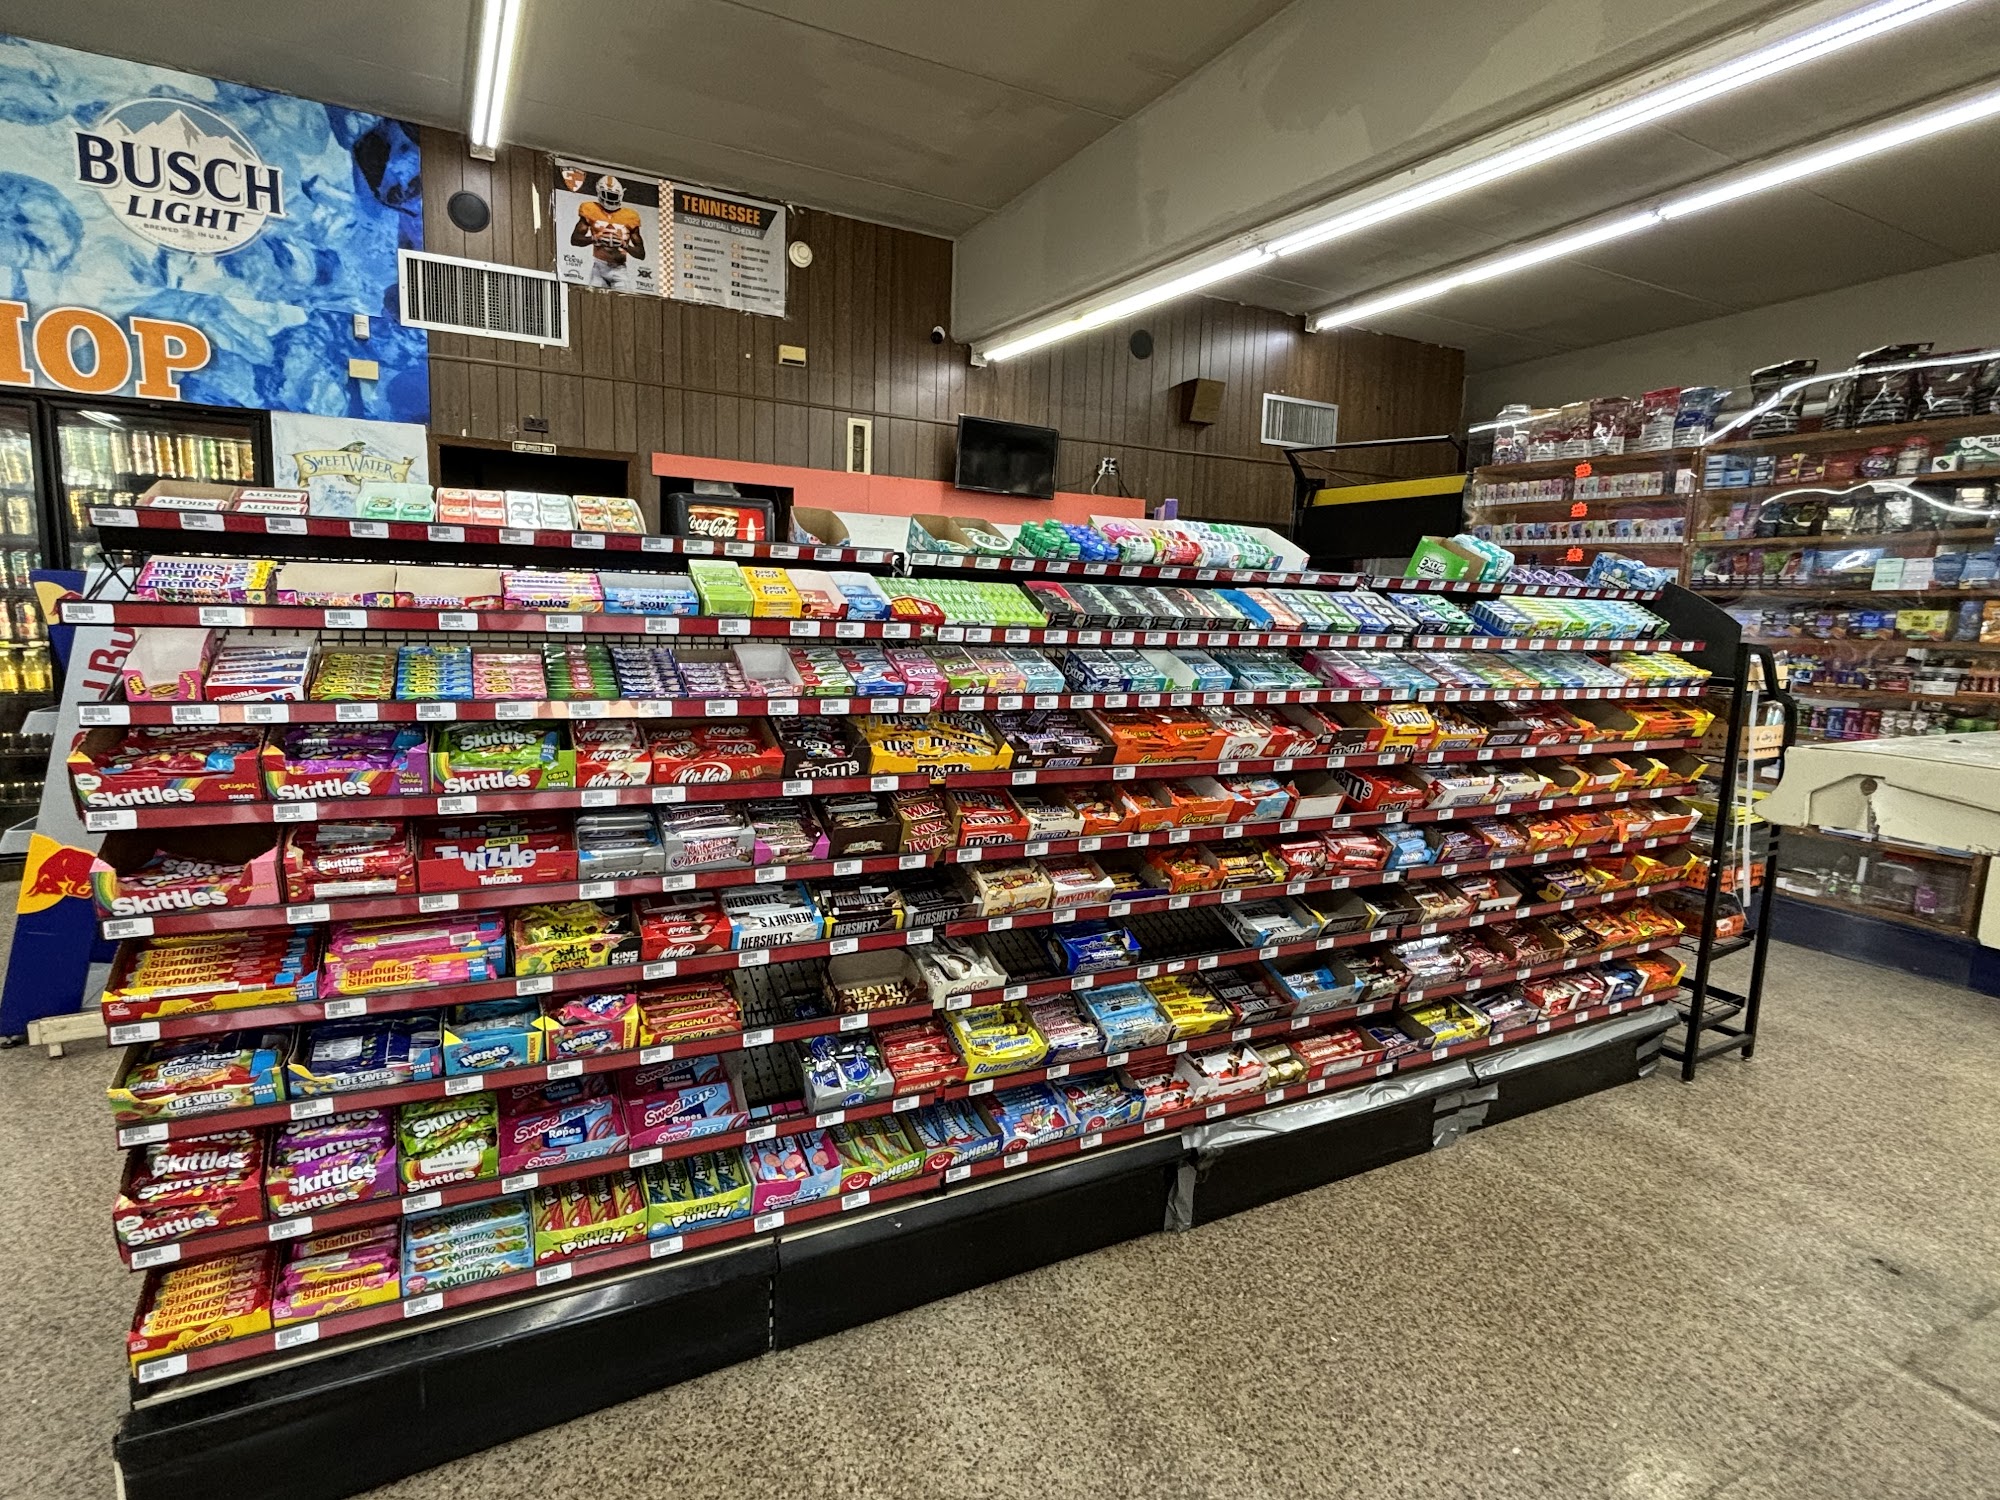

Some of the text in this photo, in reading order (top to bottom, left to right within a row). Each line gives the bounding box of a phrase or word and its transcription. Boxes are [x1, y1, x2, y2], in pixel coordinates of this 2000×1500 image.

[75, 131, 285, 218] BUSCH
[126, 193, 246, 234] LIGHT
[682, 193, 761, 226] TENNESSEE
[143, 221, 180, 235] BREWED
[683, 215, 762, 239] 2022 FOOTBALL SCHEDULE
[636, 280, 655, 289] TRULY
[514, 443, 555, 454] EMPLOYEES ONLY
[157, 499, 215, 508] ALTOIDS
[245, 504, 296, 512] ALTOIDS
[147, 580, 219, 589] mentos
[905, 665, 940, 677] Extra
[943, 660, 976, 673] Extra
[986, 665, 1018, 675] Extra
[1023, 665, 1055, 675] Extra
[1092, 665, 1121, 676] Extra
[1125, 665, 1156, 676] Extra
[1196, 665, 1226, 675] Extra
[459, 731, 537, 752] Skittles
[276, 779, 372, 801] Skittles
[443, 771, 531, 794] Skittles
[86, 785, 196, 808] Skittles
[317, 856, 365, 872] Skittles
[478, 873, 523, 886] Twizzlers
[111, 889, 228, 917] Skittles
[726, 892, 781, 909] HERSHEY'S
[834, 892, 884, 907] HERSHEY'S
[1056, 890, 1096, 906] PAYDAY
[914, 907, 960, 926] HERSHEY'S
[833, 919, 880, 936] HERSHEY'S
[740, 931, 793, 949] HERSHEY'S
[151, 944, 222, 959] Starburst
[553, 951, 586, 963] SOUR
[611, 950, 639, 960] KING
[149, 955, 220, 970] Starburst
[553, 958, 589, 972] PATCH
[142, 965, 212, 979] Starburst
[346, 970, 409, 988] Starburst
[667, 1015, 716, 1030] ZAGNUT
[973, 1054, 1042, 1075] Butterfinger
[335, 1069, 394, 1088] LIFE SAVERS
[168, 1091, 233, 1111] LIFE SAVERS
[671, 1112, 703, 1125] Ropes
[548, 1124, 581, 1139] Ropes
[950, 1139, 1000, 1166] AIRHEADS
[153, 1151, 243, 1177] Skittles
[869, 1157, 921, 1186] AIRHEADS
[286, 1164, 378, 1195] Skittles
[407, 1170, 476, 1193] Skittles
[276, 1189, 360, 1217] Skittles
[683, 1202, 719, 1216] SOUR
[671, 1206, 731, 1228] PUNCH
[126, 1213, 221, 1246] Skittles
[574, 1227, 613, 1242] SOUR
[447, 1231, 496, 1248] Mamba
[560, 1230, 627, 1255] PUNCH
[451, 1245, 497, 1263] Mamba
[172, 1255, 240, 1279] Starburst
[437, 1264, 501, 1288] Mamba
[166, 1269, 235, 1292] Starburst
[301, 1277, 364, 1300] Starburst
[164, 1282, 234, 1306] Starburst
[157, 1294, 227, 1318] Starburst
[154, 1306, 226, 1331] Starburst
